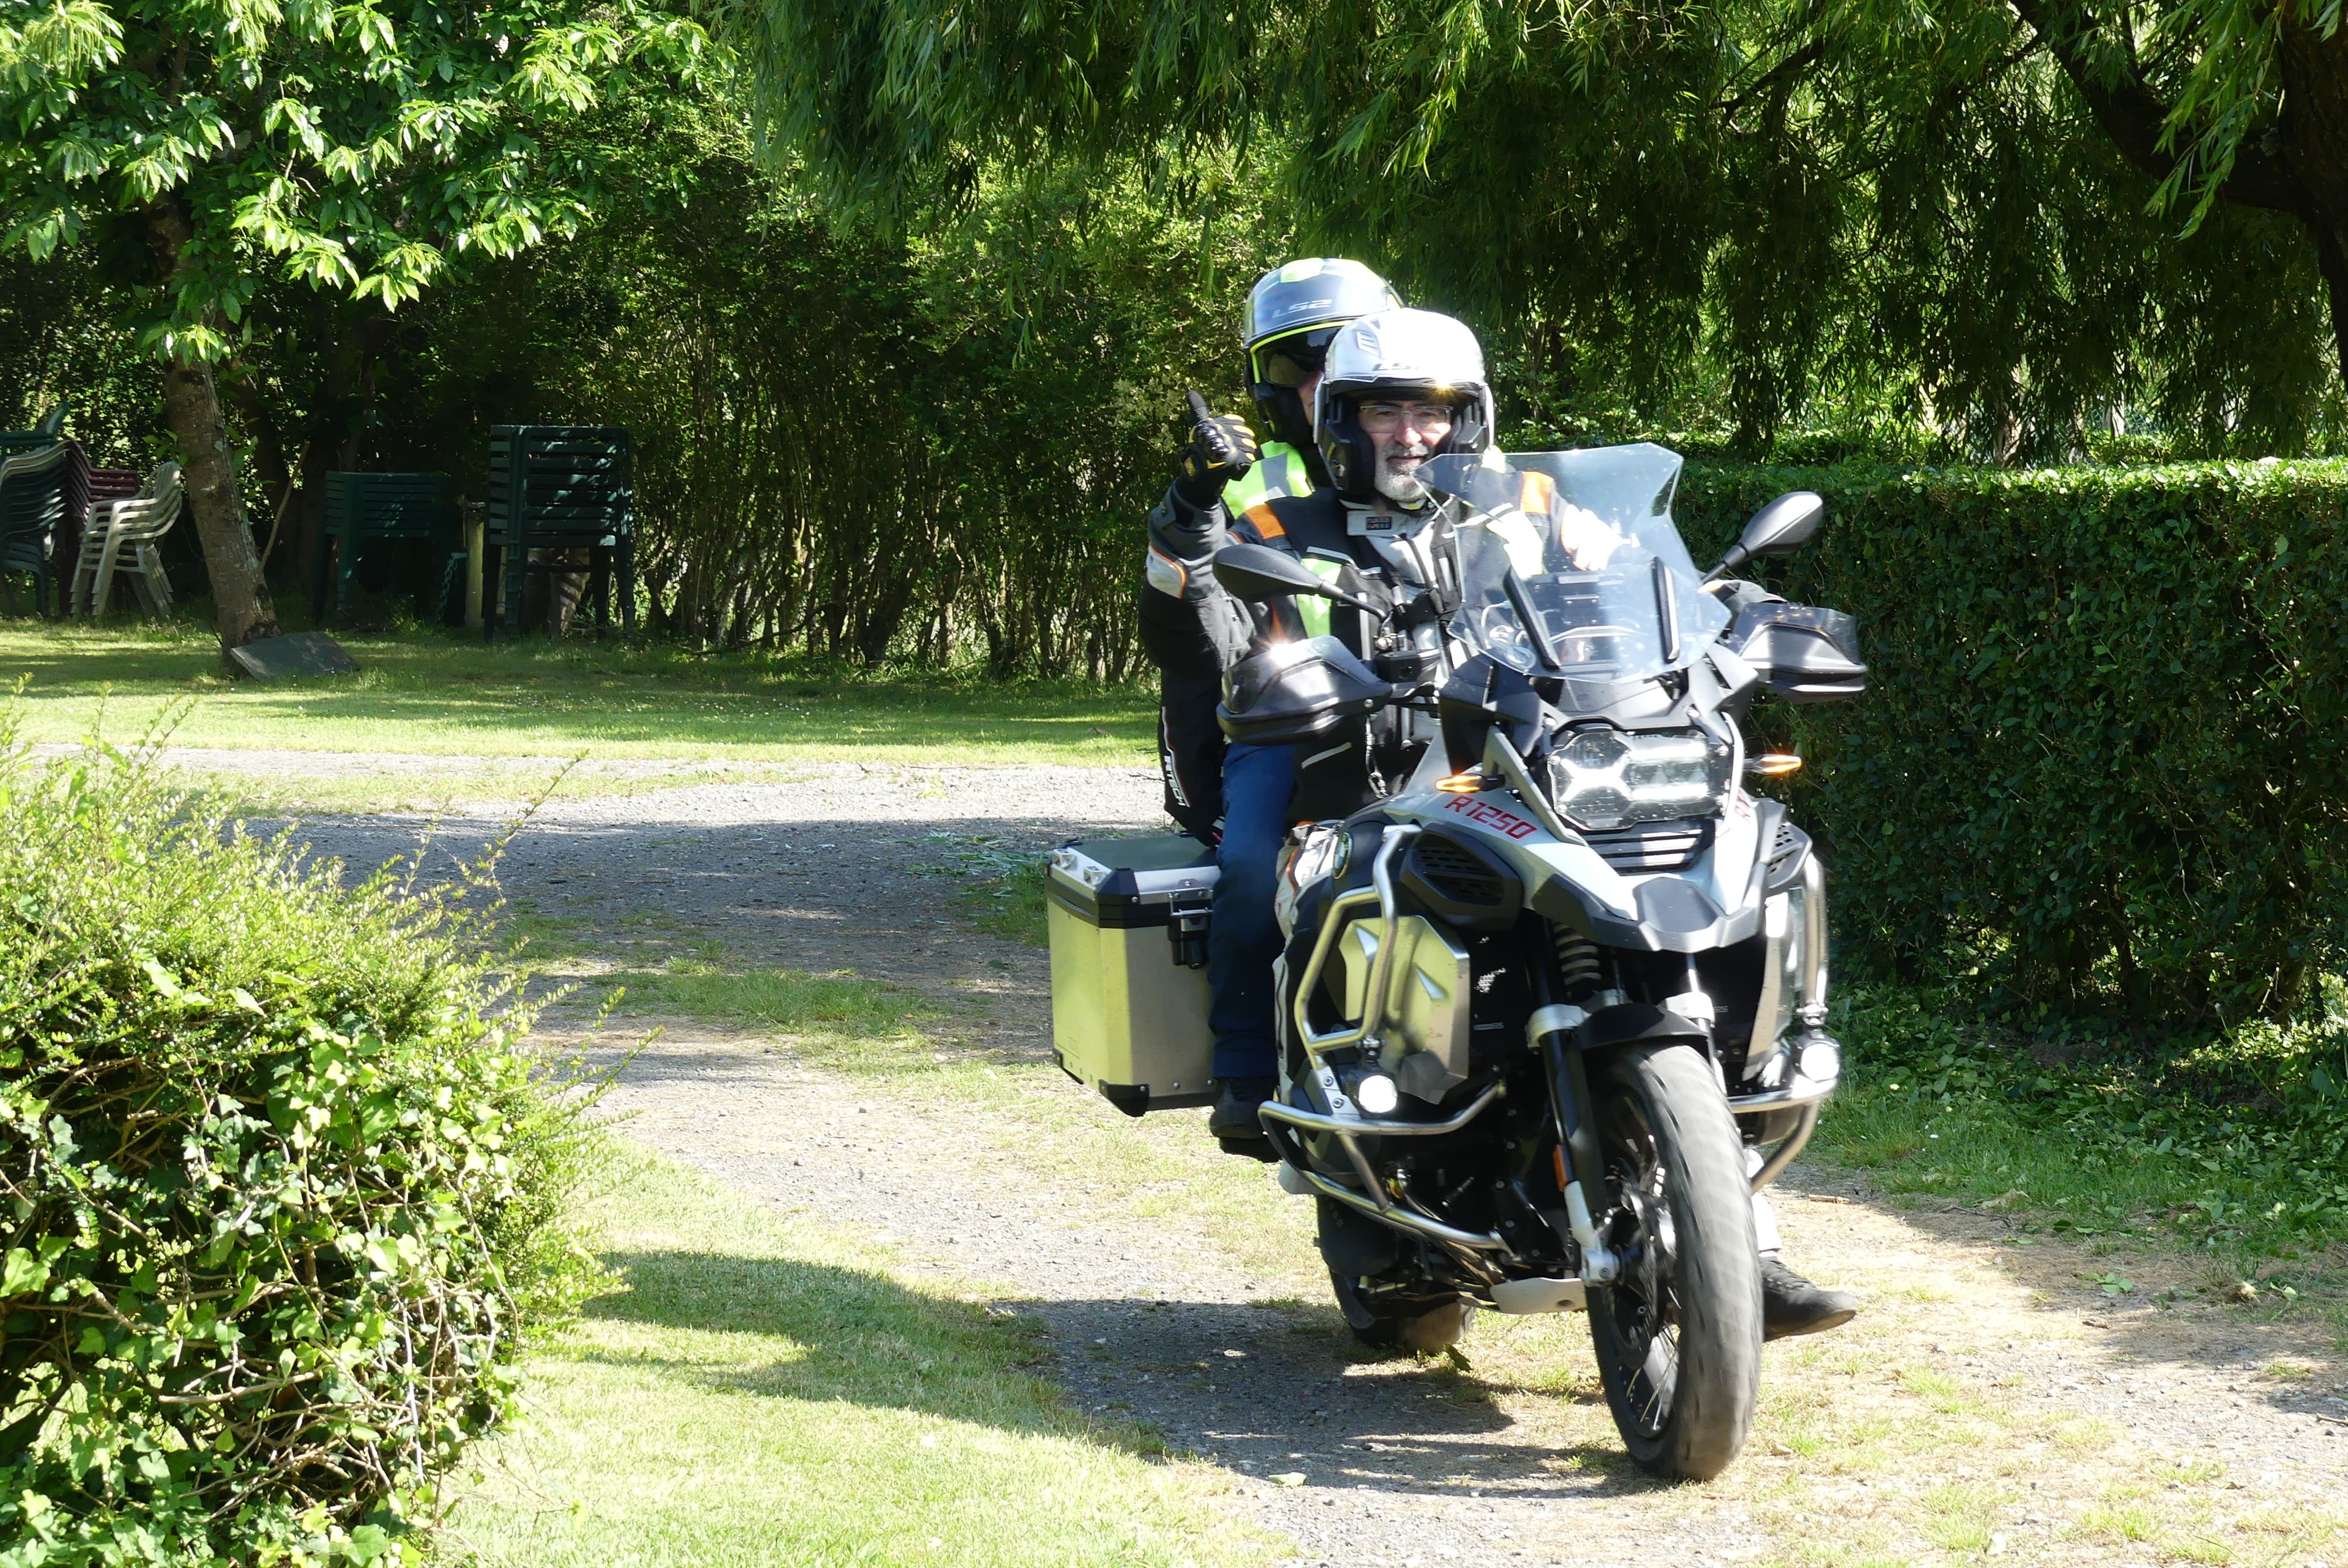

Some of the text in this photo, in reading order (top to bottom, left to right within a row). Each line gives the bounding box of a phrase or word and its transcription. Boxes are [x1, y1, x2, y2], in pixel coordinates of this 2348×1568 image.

[1271, 299, 1332, 318] LS2
[1372, 363, 1419, 371] LS
[1465, 802, 1537, 839] 1250
